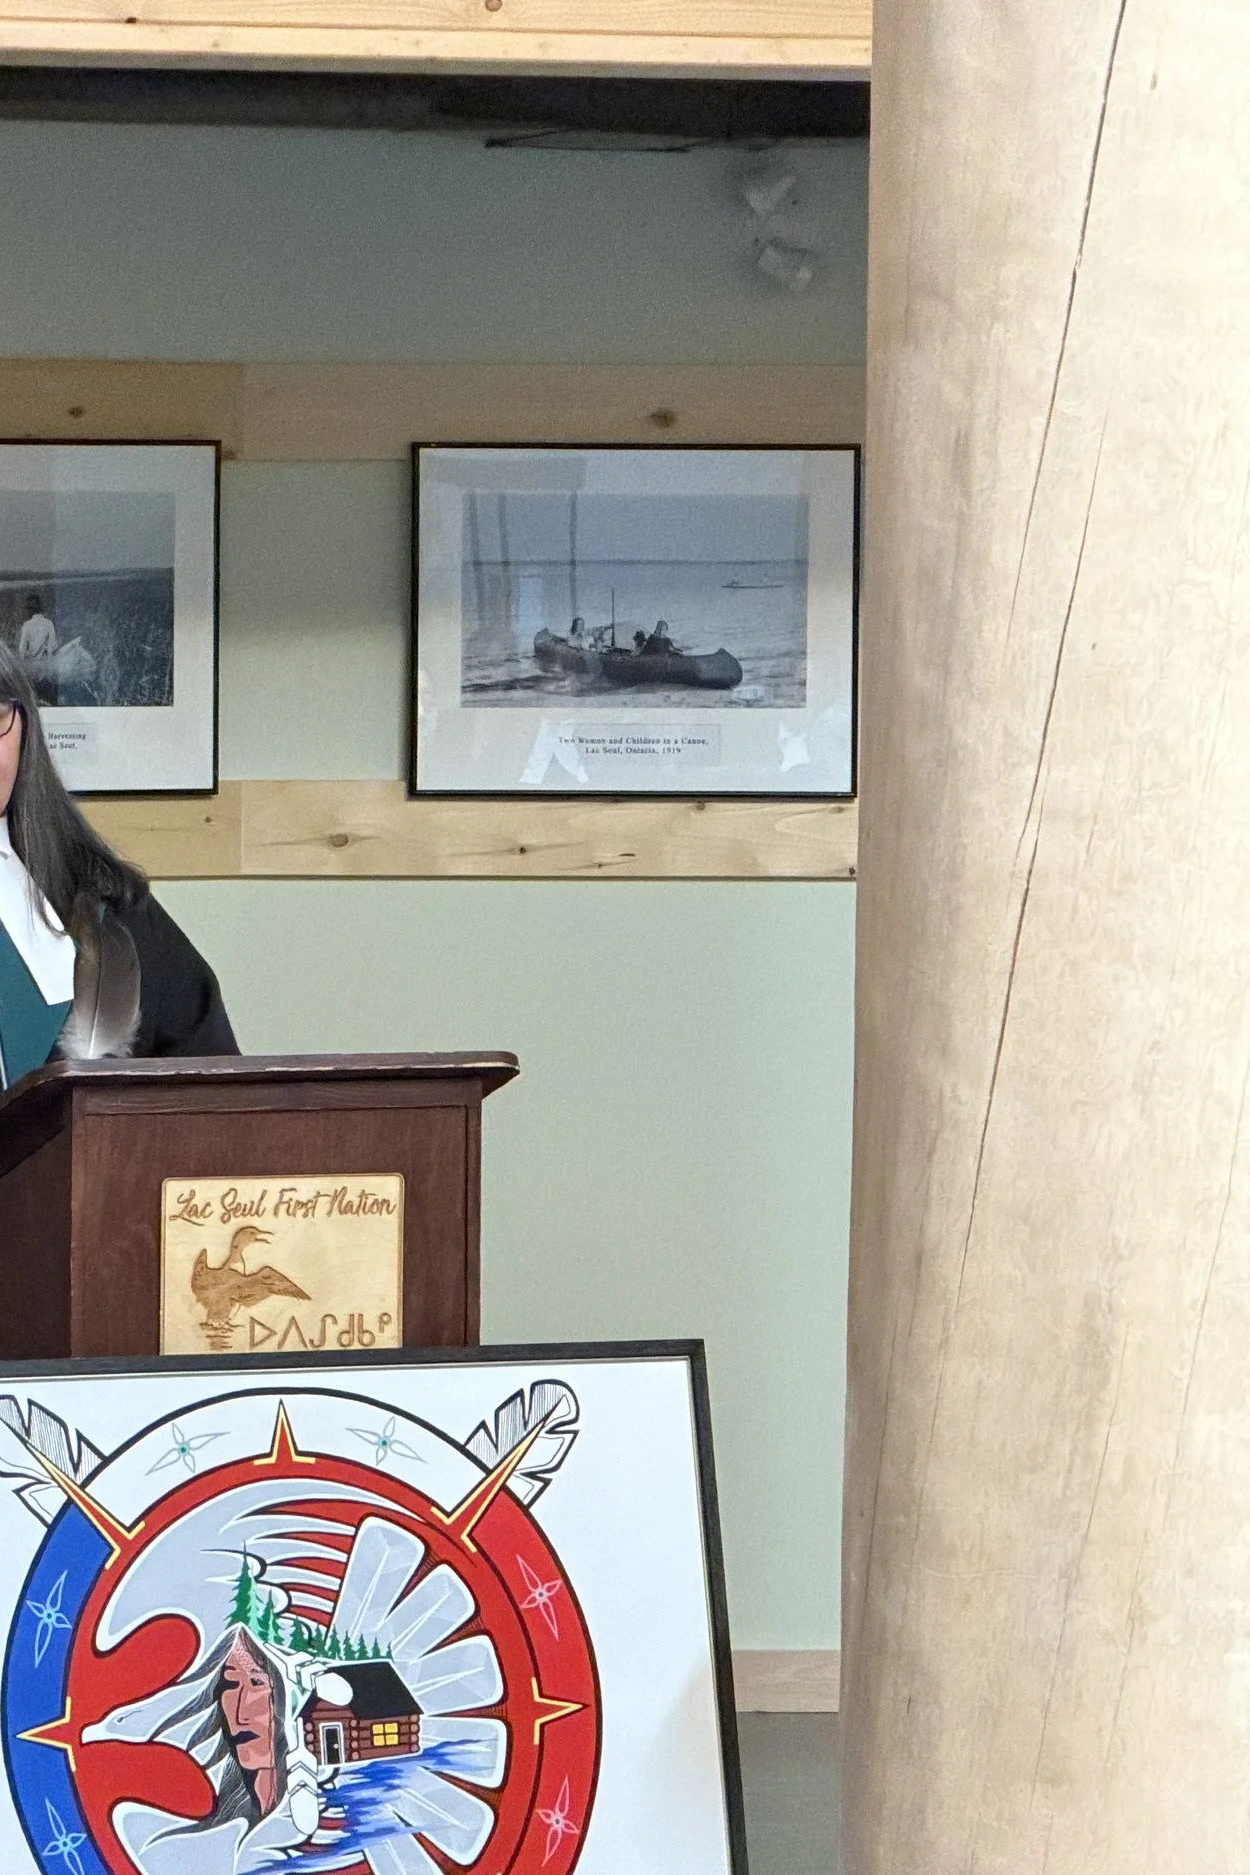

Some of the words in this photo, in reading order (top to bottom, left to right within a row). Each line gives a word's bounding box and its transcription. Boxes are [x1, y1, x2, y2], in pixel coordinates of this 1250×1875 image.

[48, 732, 86, 741] Harvesting
[558, 736, 576, 745] Two
[578, 736, 606, 745] Women
[608, 736, 623, 745] and
[625, 735, 661, 745] Children
[663, 736, 672, 745] in
[681, 736, 709, 746] Canoe,
[585, 746, 600, 755] Lac
[662, 746, 682, 755] 1919
[169, 1188, 214, 1227] Lac
[220, 1187, 267, 1225] Seul
[273, 1187, 331, 1218] First
[326, 1185, 397, 1218] Nation
